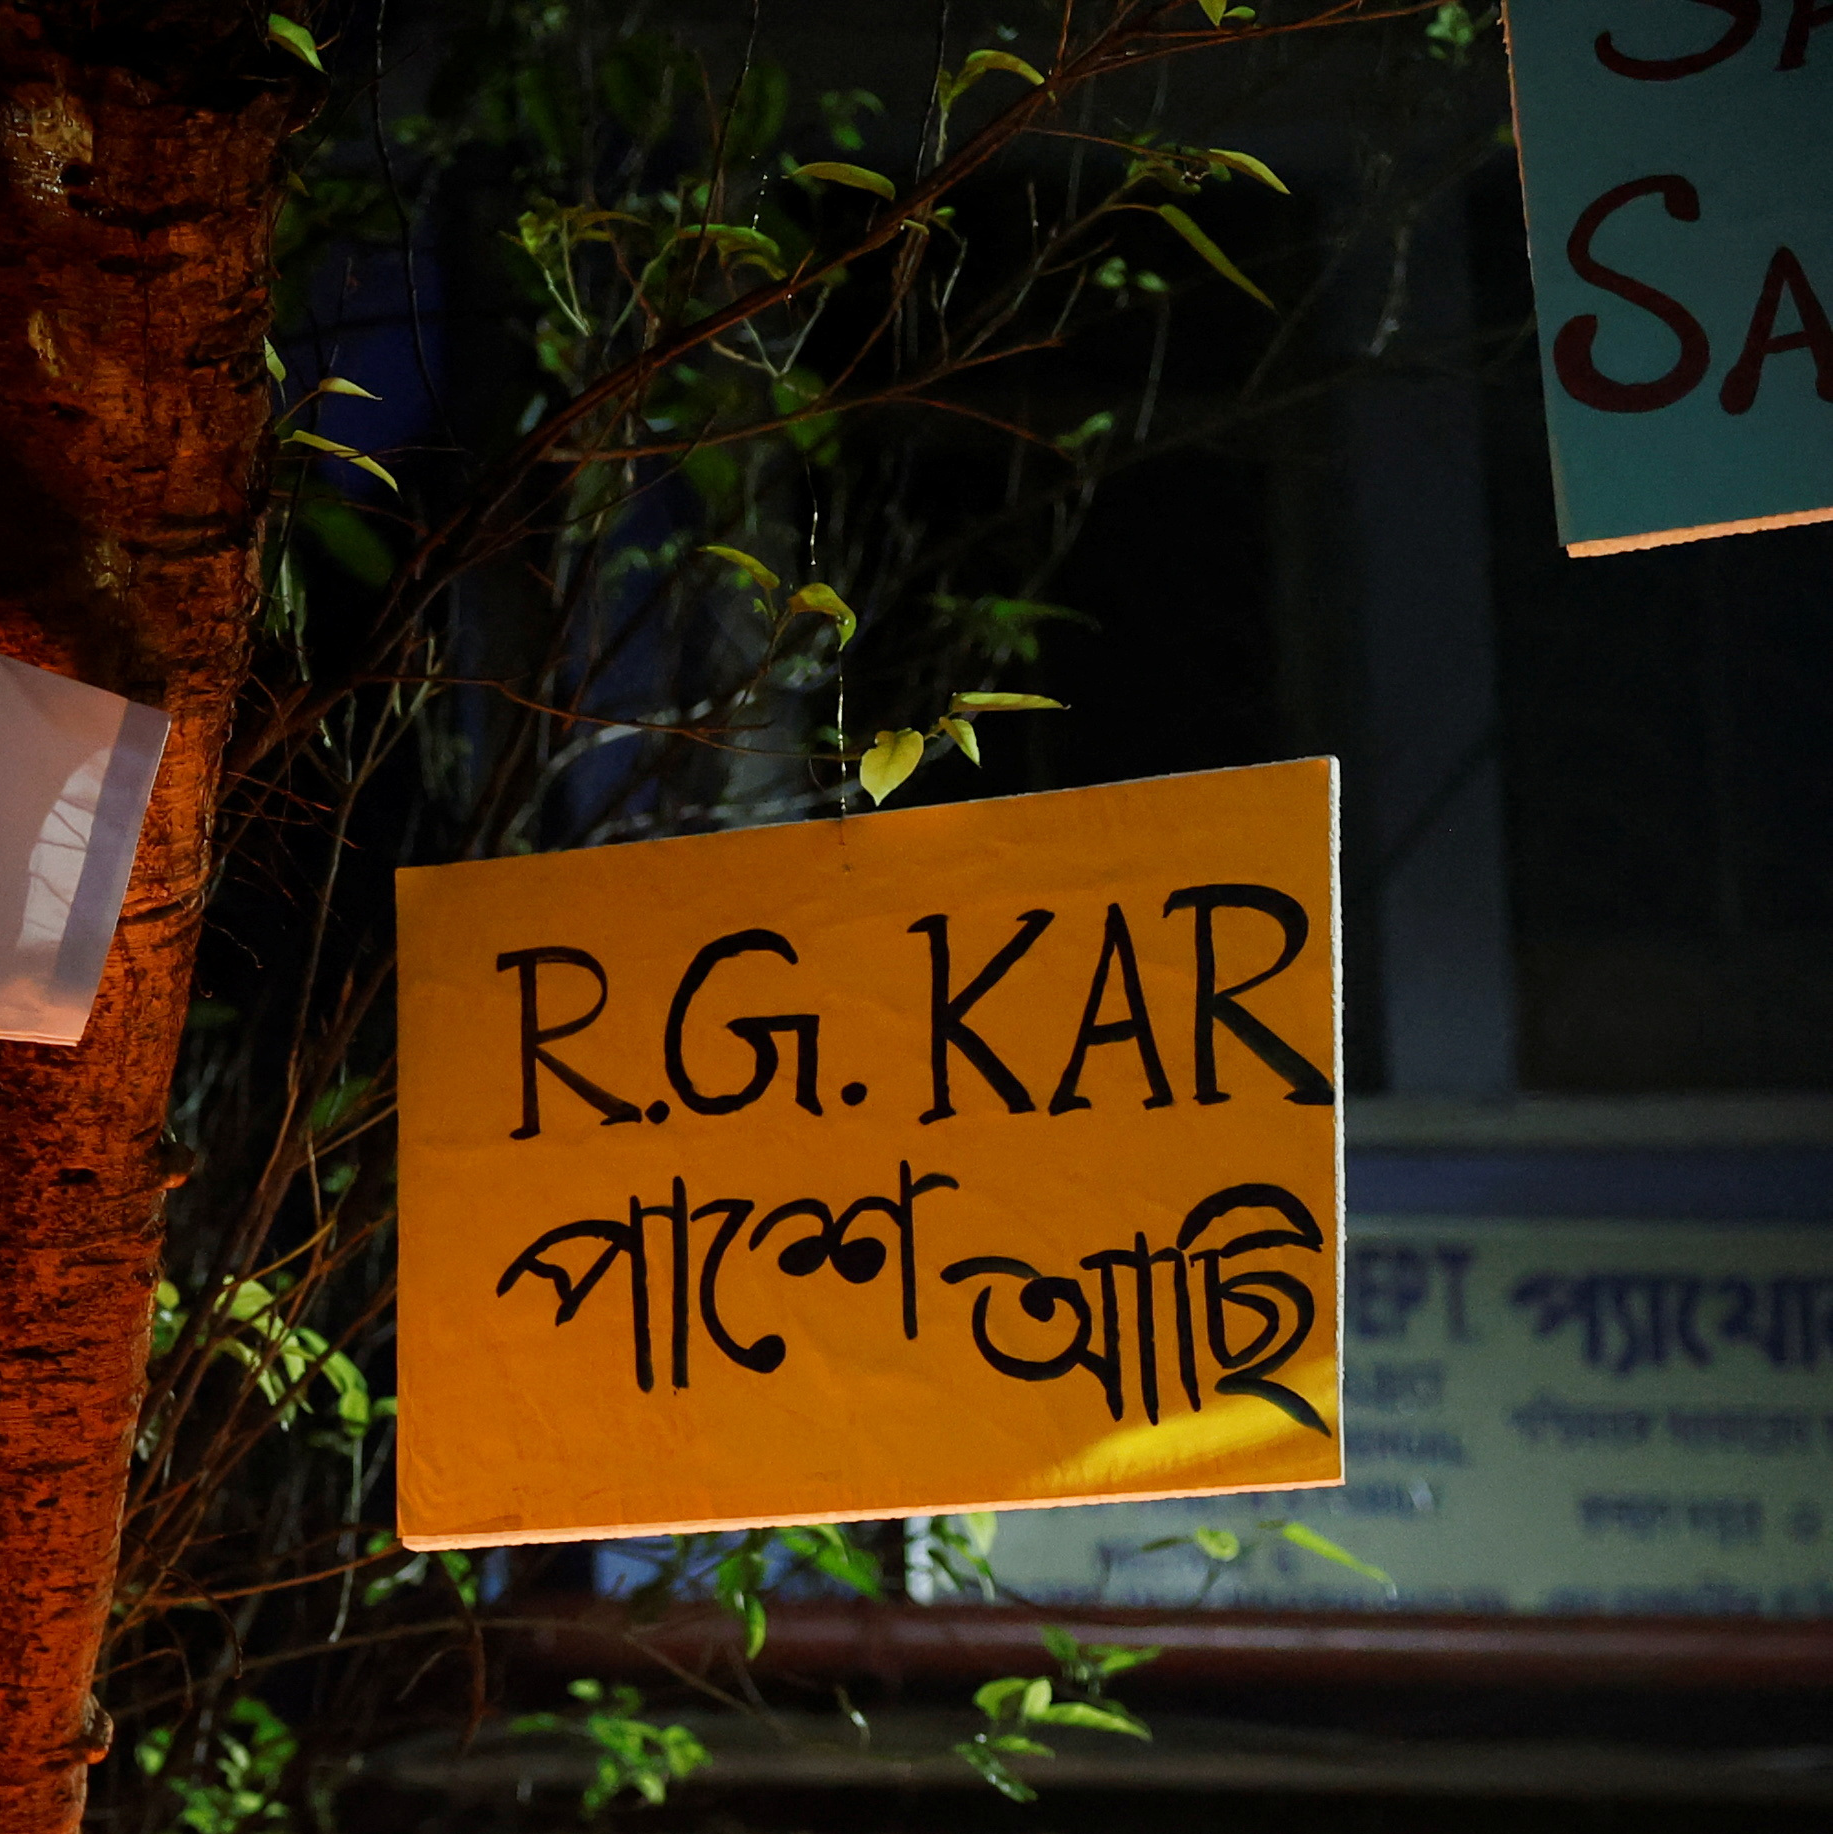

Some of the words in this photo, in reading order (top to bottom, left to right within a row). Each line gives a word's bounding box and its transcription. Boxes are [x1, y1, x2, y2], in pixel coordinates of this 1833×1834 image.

[907, 883, 1333, 1125] KAR
[496, 1160, 960, 1394] পাশে
[940, 1183, 1332, 1437] আছি
[1346, 1244, 1478, 1346] EPT
[1511, 1266, 1833, 1377] প্যাথো
